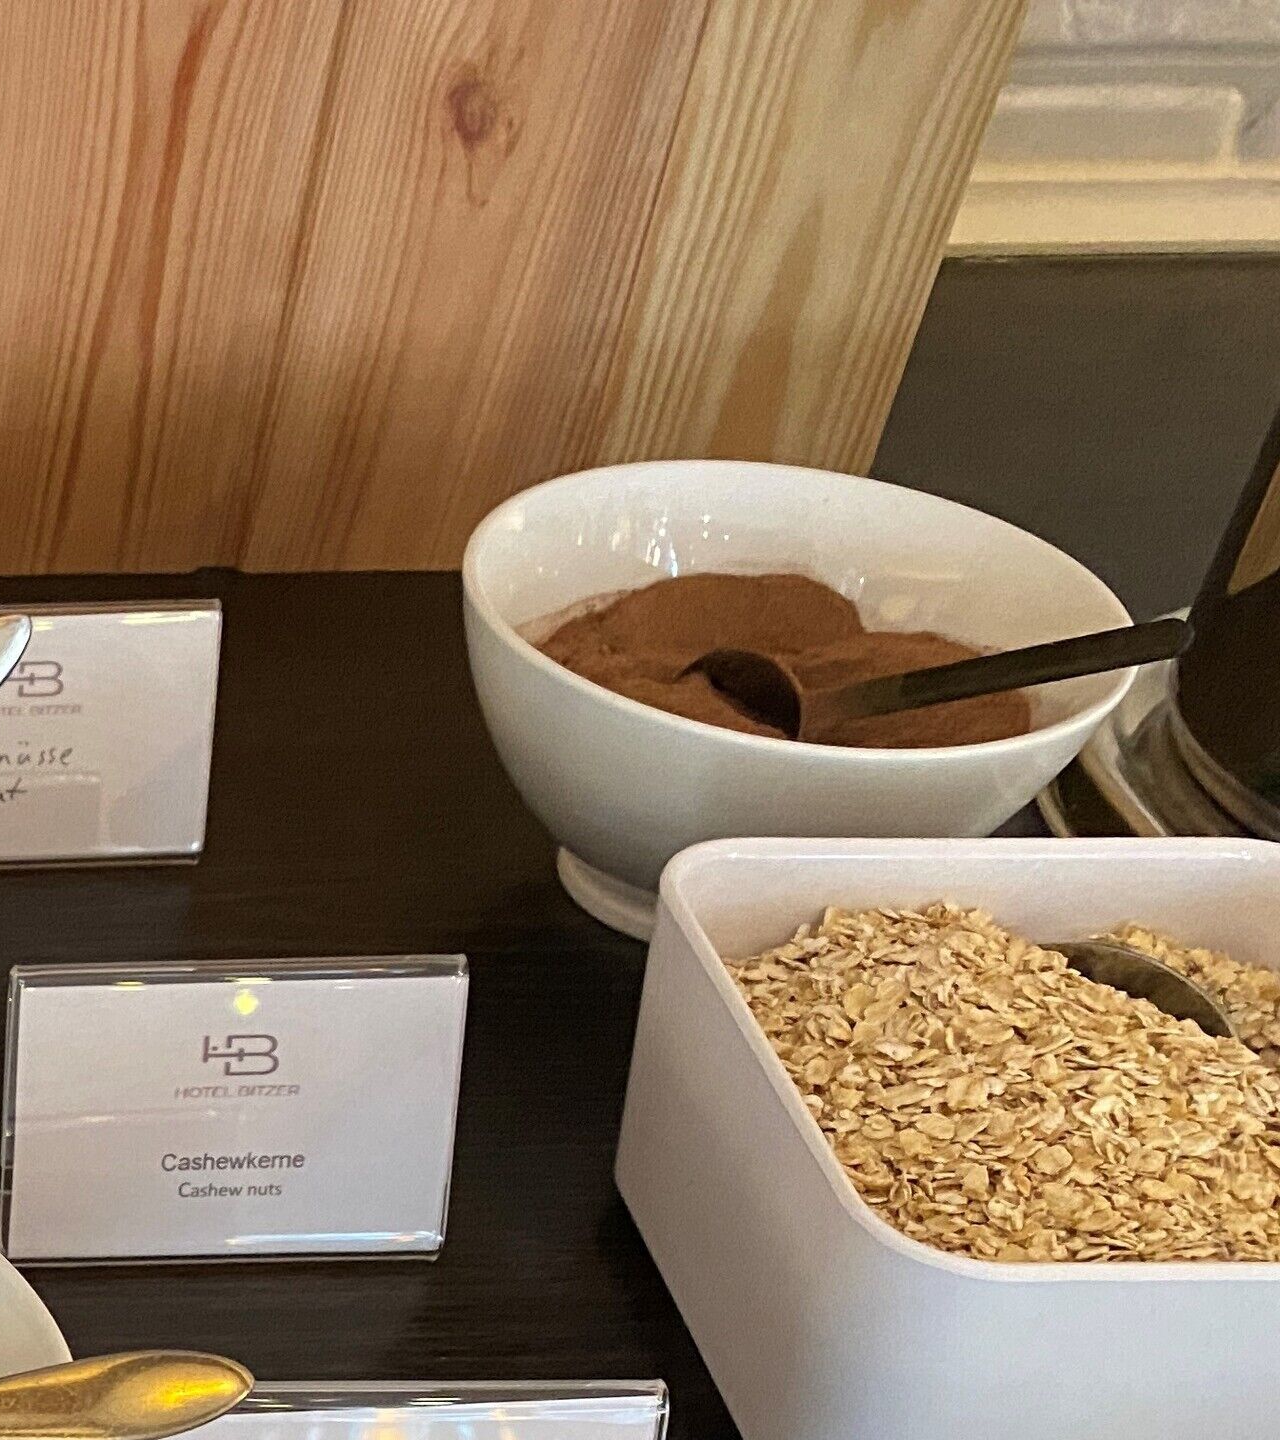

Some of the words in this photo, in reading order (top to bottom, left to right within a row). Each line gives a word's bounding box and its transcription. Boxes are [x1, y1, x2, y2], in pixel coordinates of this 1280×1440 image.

[174, 1086, 232, 1099] HOTEL
[237, 1085, 300, 1097] BITZER
[161, 1152, 305, 1172] Cashewkerne
[178, 1181, 243, 1198] Cashew
[247, 1182, 282, 1197] nuts
